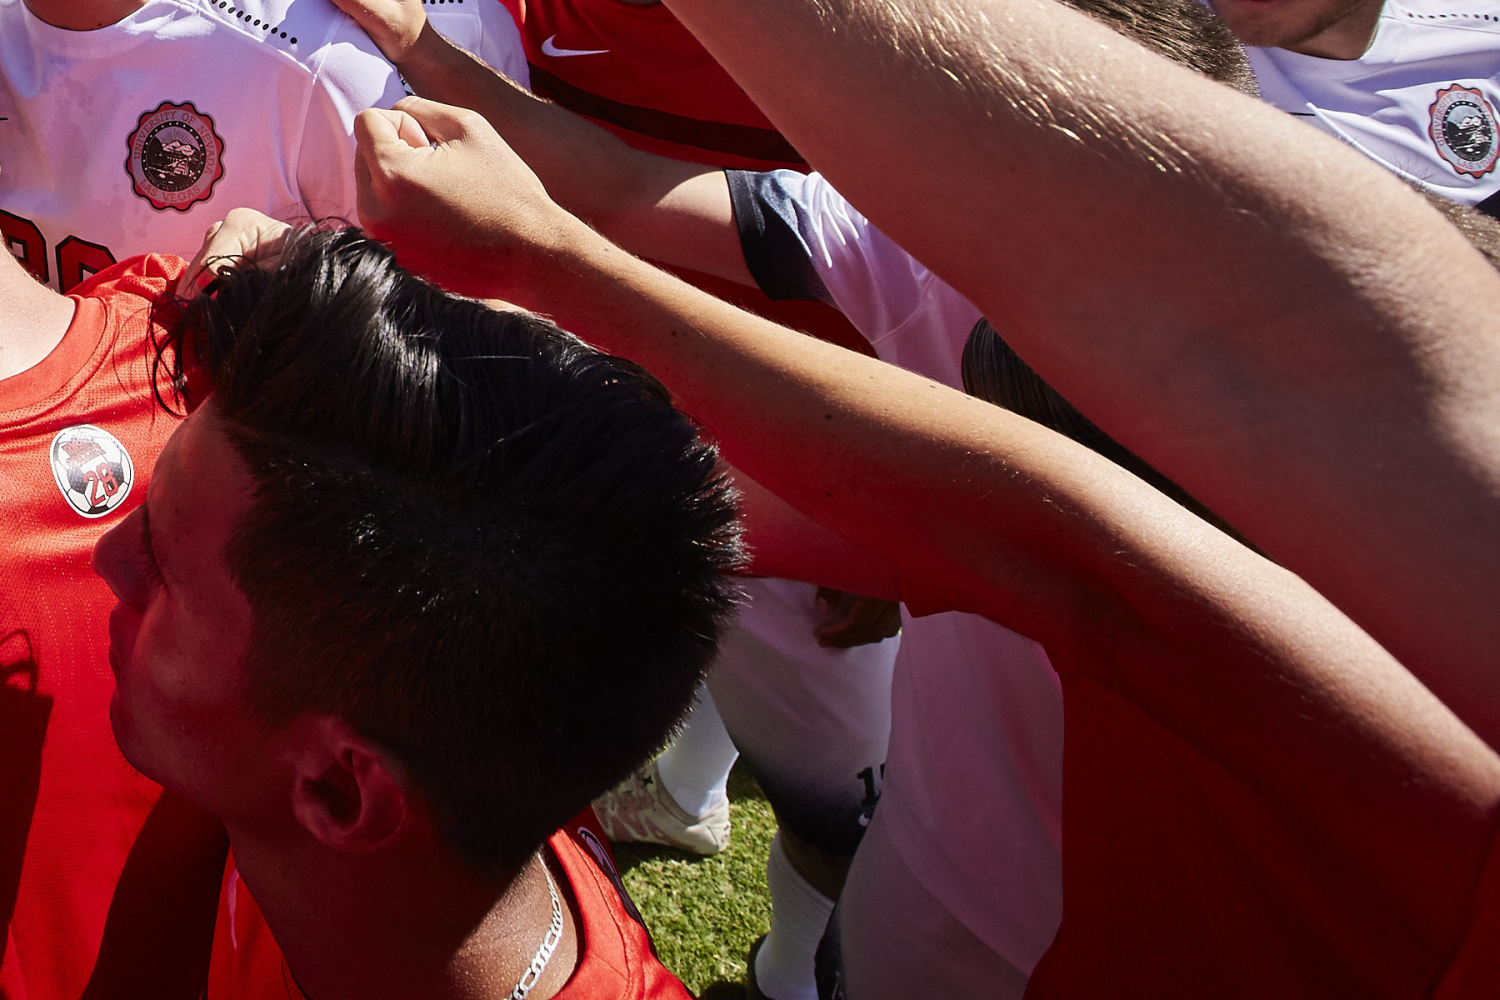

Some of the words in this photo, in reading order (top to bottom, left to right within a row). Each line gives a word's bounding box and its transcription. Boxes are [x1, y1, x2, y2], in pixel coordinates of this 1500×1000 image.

[134, 110, 177, 160] UNIVERSITY
[181, 112, 197, 126] OF
[197, 125, 216, 175] NEVADA
[139, 178, 159, 198] LAS
[162, 185, 201, 203] VEGAS
[83, 463, 119, 507] 28
